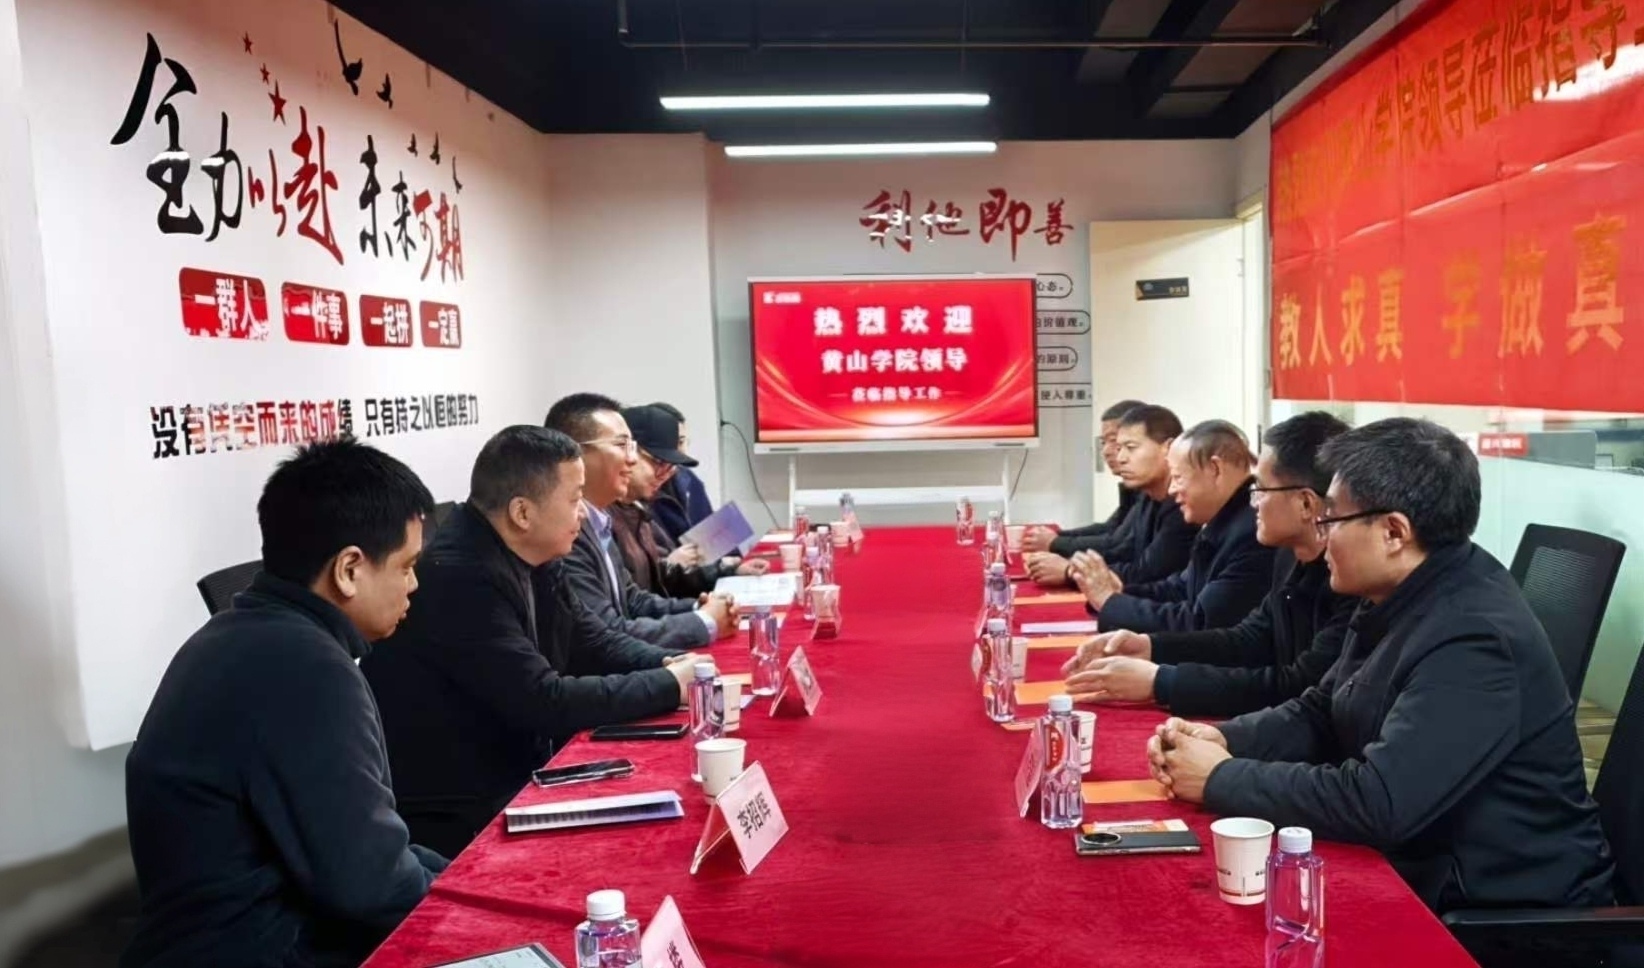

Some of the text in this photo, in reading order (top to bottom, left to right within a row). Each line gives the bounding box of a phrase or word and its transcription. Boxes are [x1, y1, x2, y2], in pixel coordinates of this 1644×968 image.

[110, 32, 464, 283] 全力以赴 未来可期
[859, 187, 1074, 262] 利他即善
[194, 278, 269, 339] 一群人
[290, 289, 343, 340] 一件事
[370, 301, 409, 344] 一起拼
[814, 306, 973, 335] 热烈欢迎
[821, 348, 968, 373] 黄山学院领导
